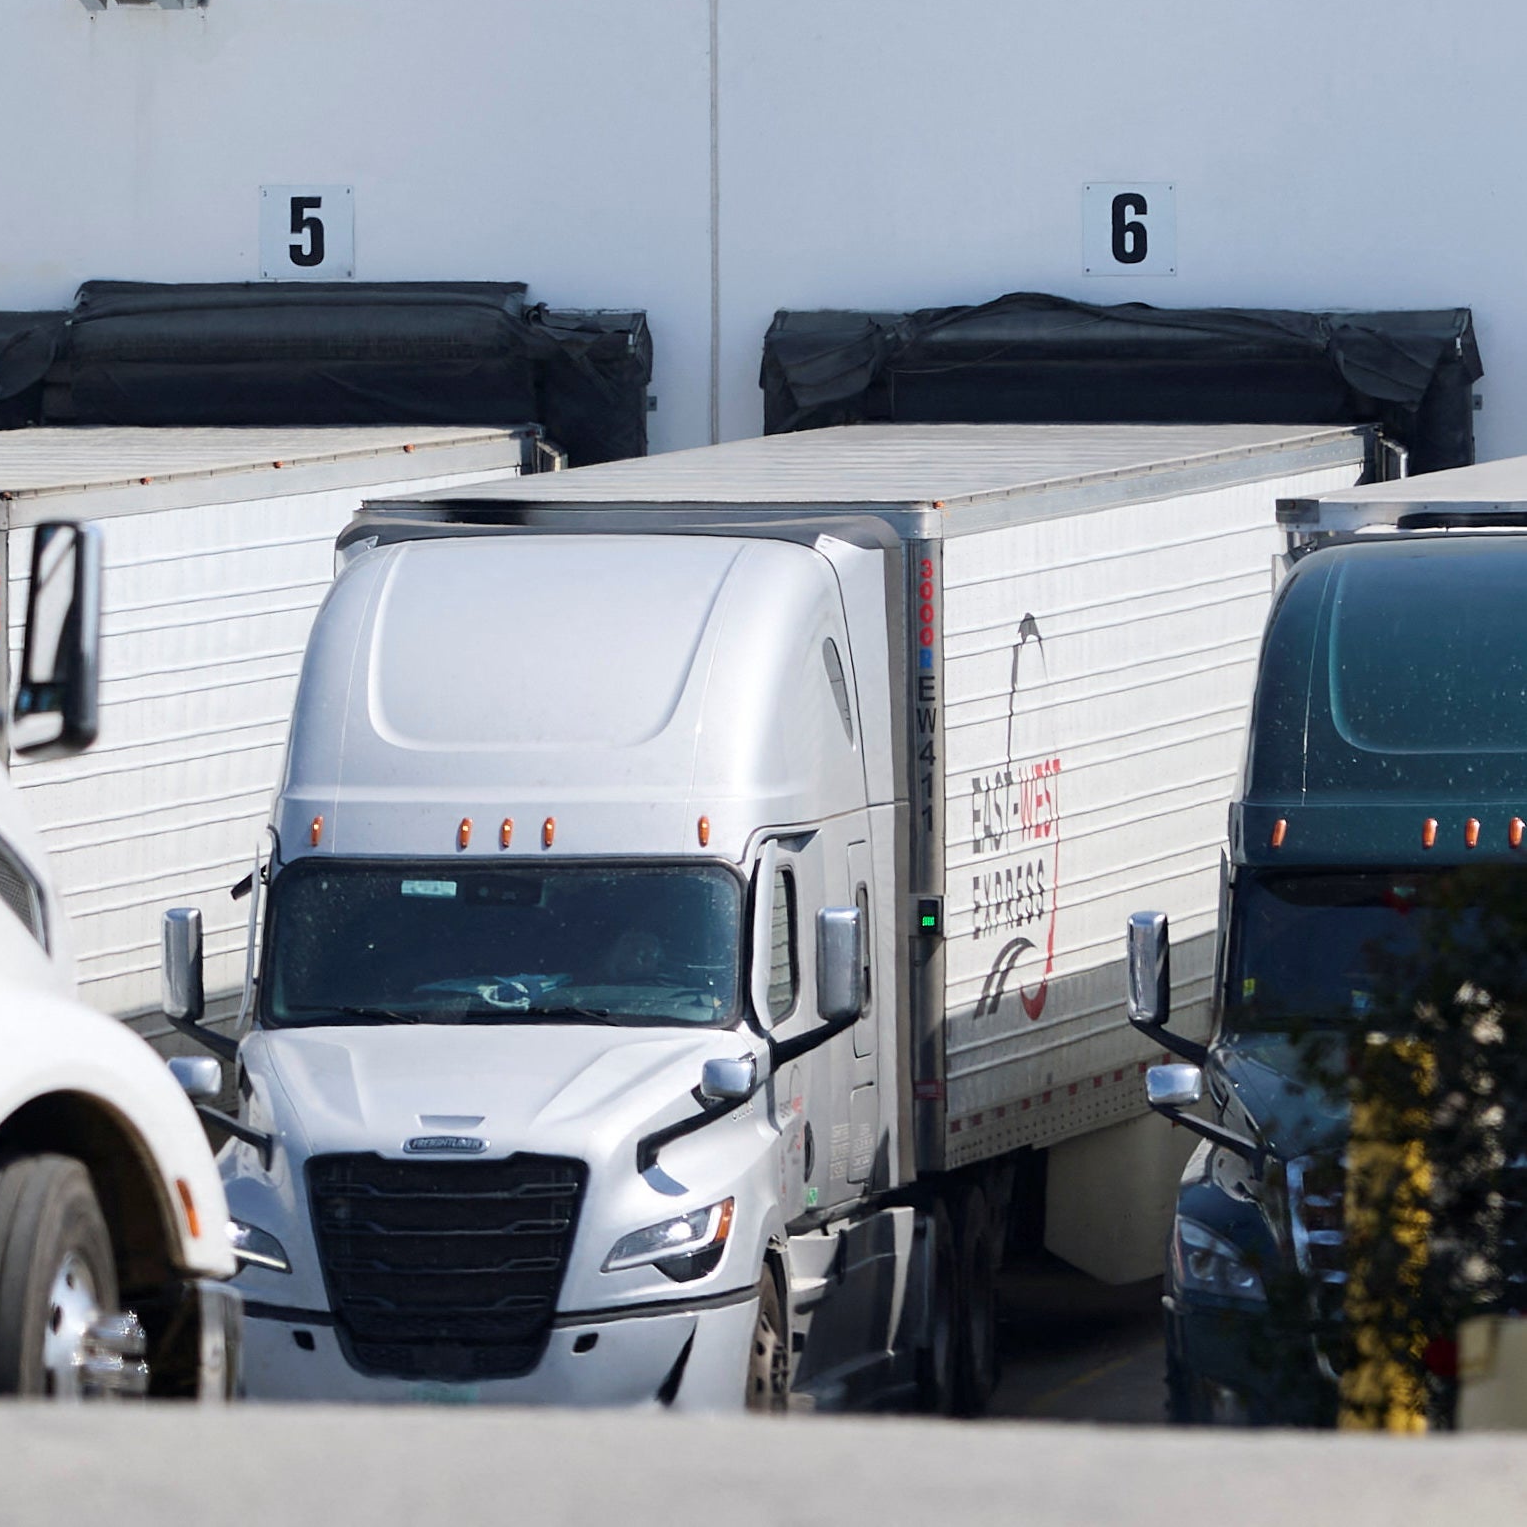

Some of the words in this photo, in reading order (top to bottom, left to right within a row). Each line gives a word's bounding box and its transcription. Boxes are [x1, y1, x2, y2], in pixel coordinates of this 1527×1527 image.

[288, 196, 325, 267] 5
[1111, 192, 1148, 265] 6
[915, 675, 938, 832] EW411
[971, 758, 1061, 855] EAST-WEST
[972, 857, 1045, 940] EXPRESS
